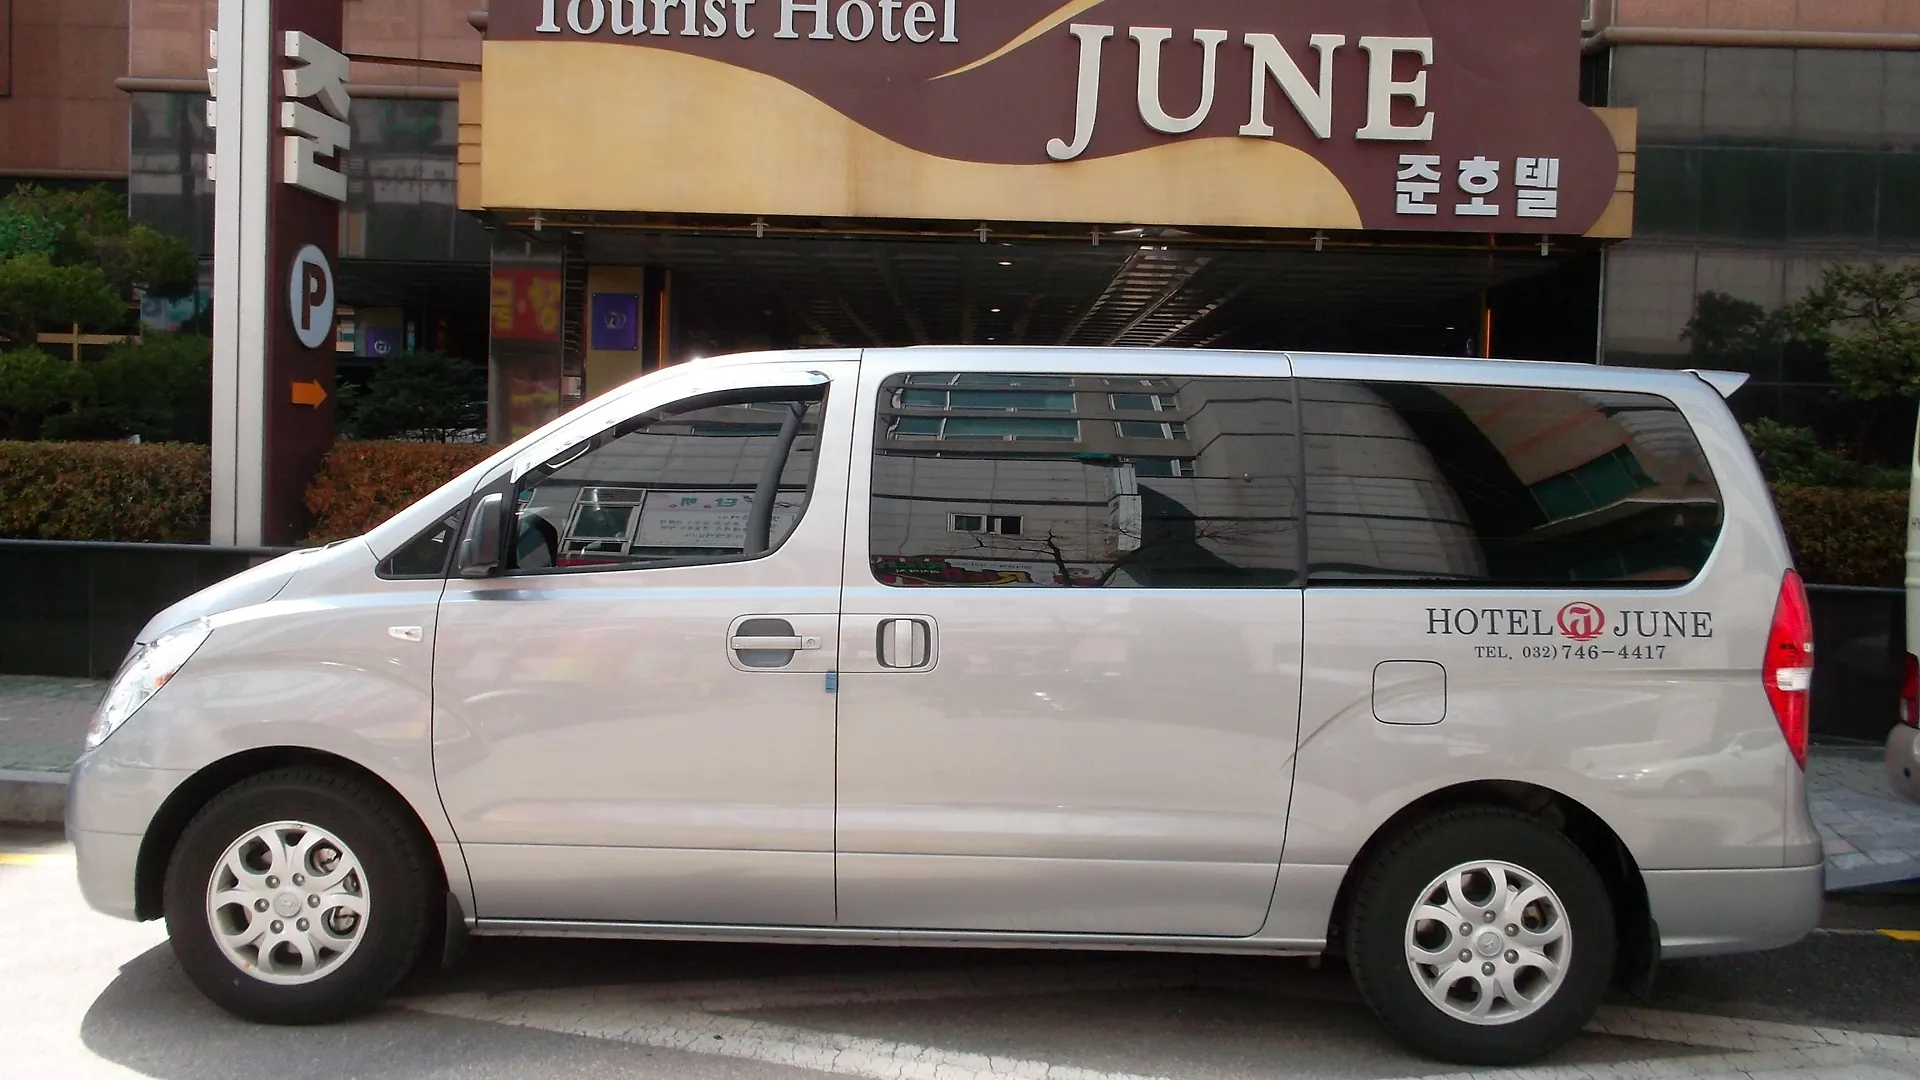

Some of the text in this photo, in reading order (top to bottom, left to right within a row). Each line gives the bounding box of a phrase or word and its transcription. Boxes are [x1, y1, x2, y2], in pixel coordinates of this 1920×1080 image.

[773, 0, 959, 43] Hotel
[1046, 23, 1435, 161] JUNE
[1396, 154, 1560, 218] 준호텔
[301, 261, 327, 331] P
[1425, 608, 1554, 635] HOTEL
[1613, 610, 1713, 638] JUNE
[1474, 646, 1513, 660] TEL.
